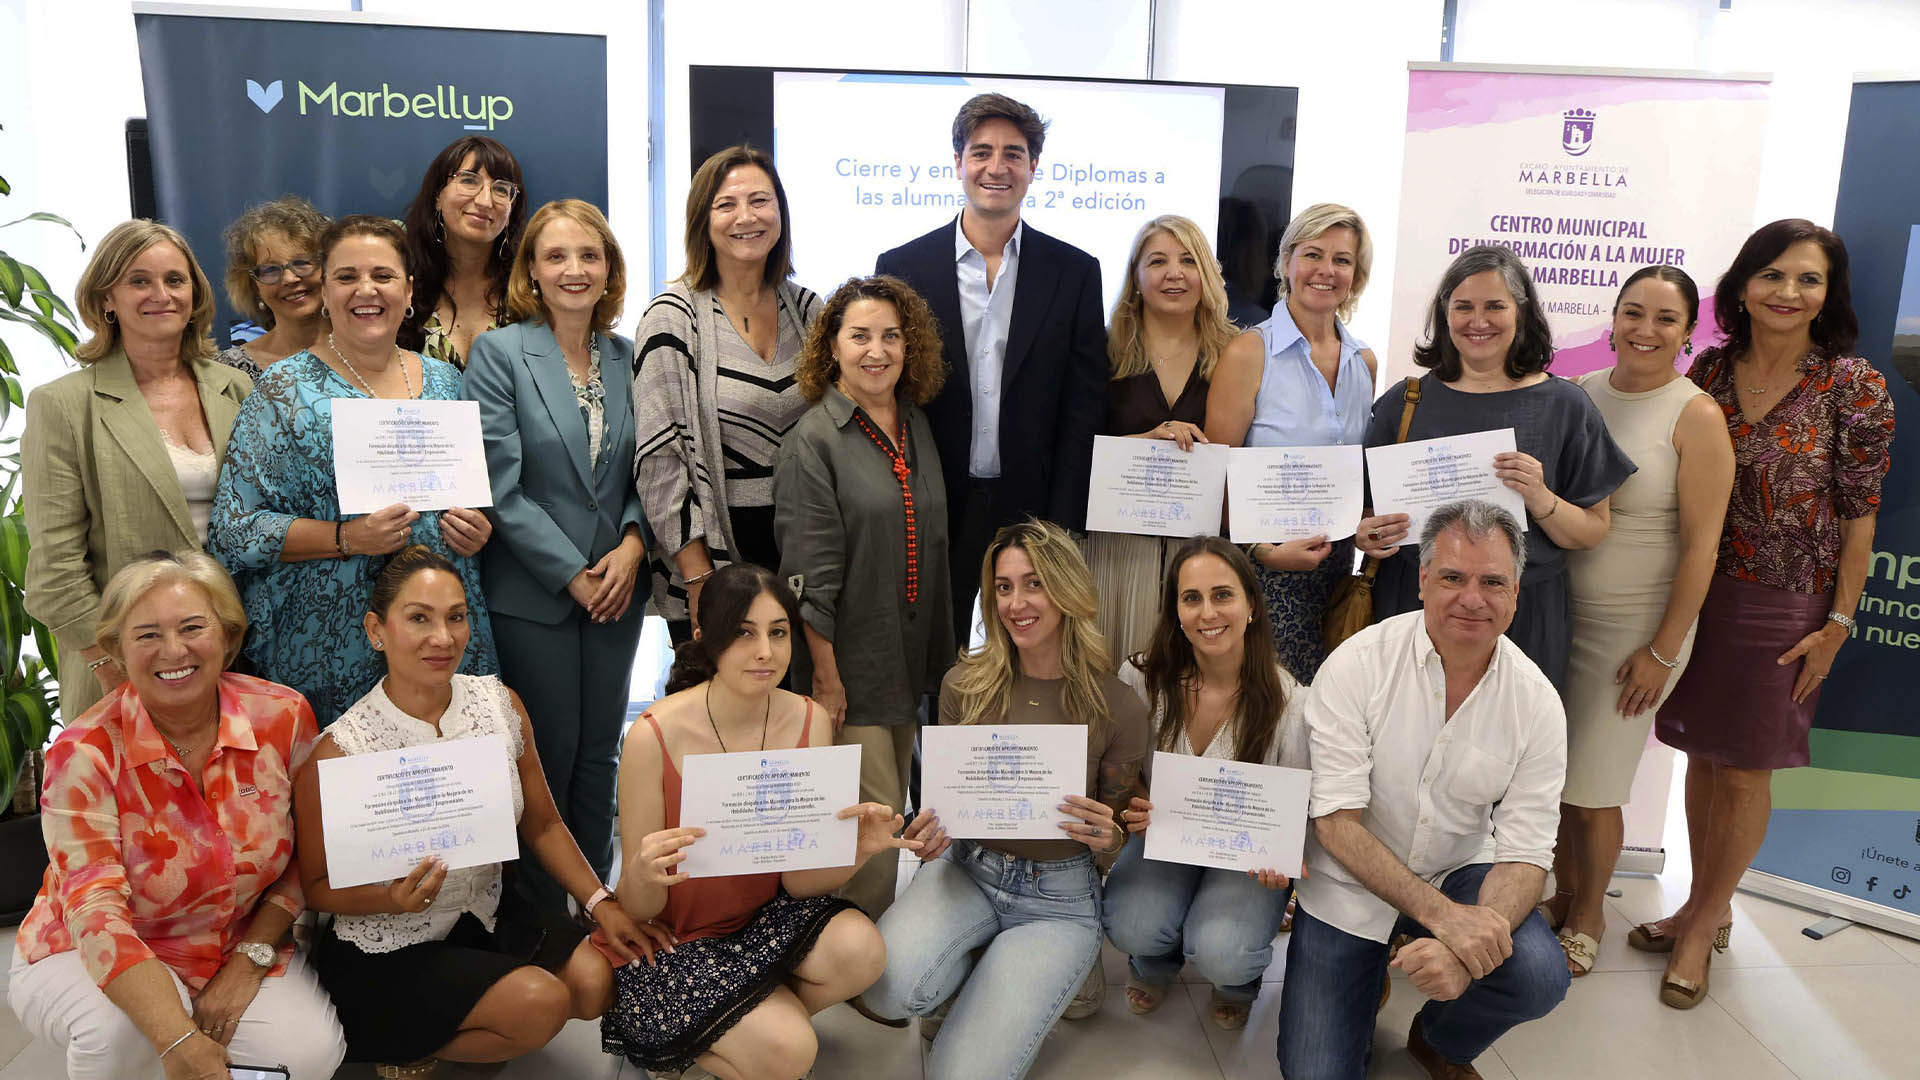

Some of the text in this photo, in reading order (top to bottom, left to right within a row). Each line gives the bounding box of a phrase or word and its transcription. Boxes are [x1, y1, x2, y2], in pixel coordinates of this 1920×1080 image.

[298, 80, 514, 131] Marbellup
[835, 158, 901, 178] Cierre
[908, 165, 921, 183] y
[1052, 163, 1148, 187] Diplomas
[1154, 171, 1166, 184] a
[1519, 170, 1628, 187] MARBELLA
[1553, 164, 1617, 173] AYUNTAMIENTO
[855, 186, 884, 205] las
[891, 187, 967, 206] alumna
[1044, 191, 1065, 209] 2ª
[1072, 192, 1146, 211] edición
[1490, 215, 1648, 239] CENTRO MUNICIPAL
[1590, 244, 1601, 262] A
[1605, 246, 1625, 263] LA
[1630, 248, 1685, 266] MUJER
[1533, 266, 1619, 288] MARBELLA
[1547, 303, 1600, 316] MARBELLA
[1867, 551, 1920, 589] mp
[1859, 591, 1920, 620] inno
[1866, 626, 1920, 650] nue
[1861, 847, 1909, 868] ¡Únete
